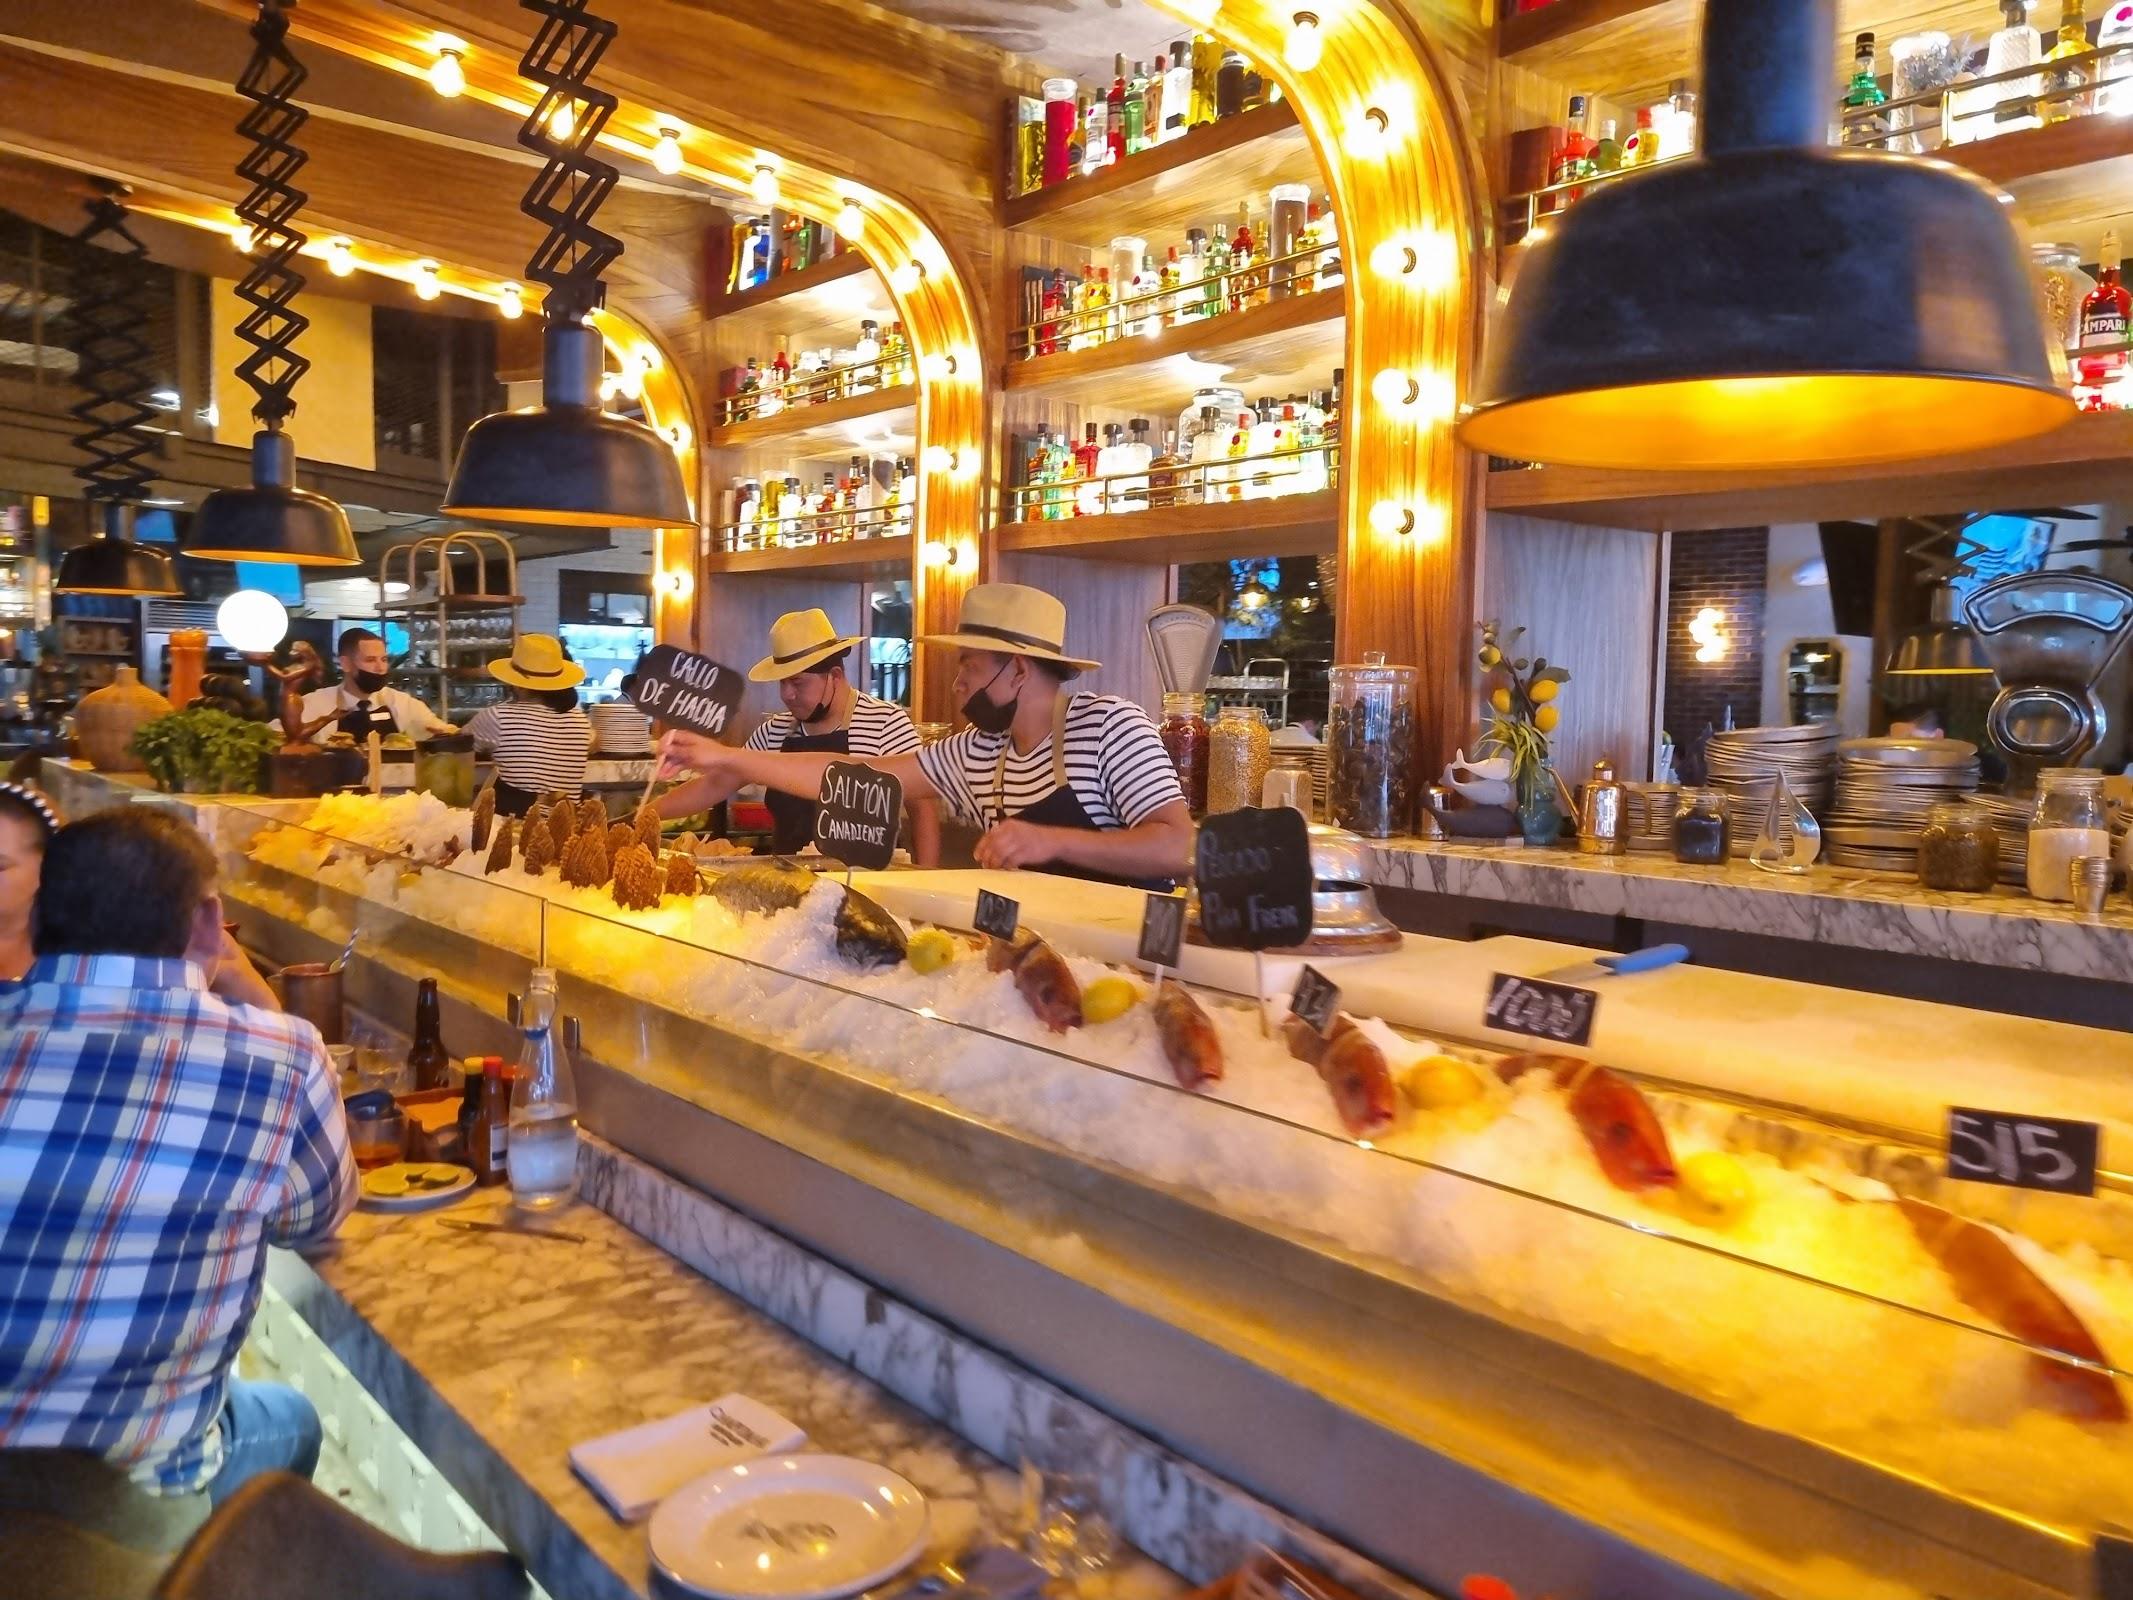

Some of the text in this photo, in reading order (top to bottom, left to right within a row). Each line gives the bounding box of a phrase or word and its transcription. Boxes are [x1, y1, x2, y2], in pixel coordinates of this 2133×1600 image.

[671, 652, 719, 690] CALLO
[640, 677, 728, 734] DE HACHA
[821, 766, 892, 823] SALMÓN
[817, 809, 887, 846] CANADIENSE
